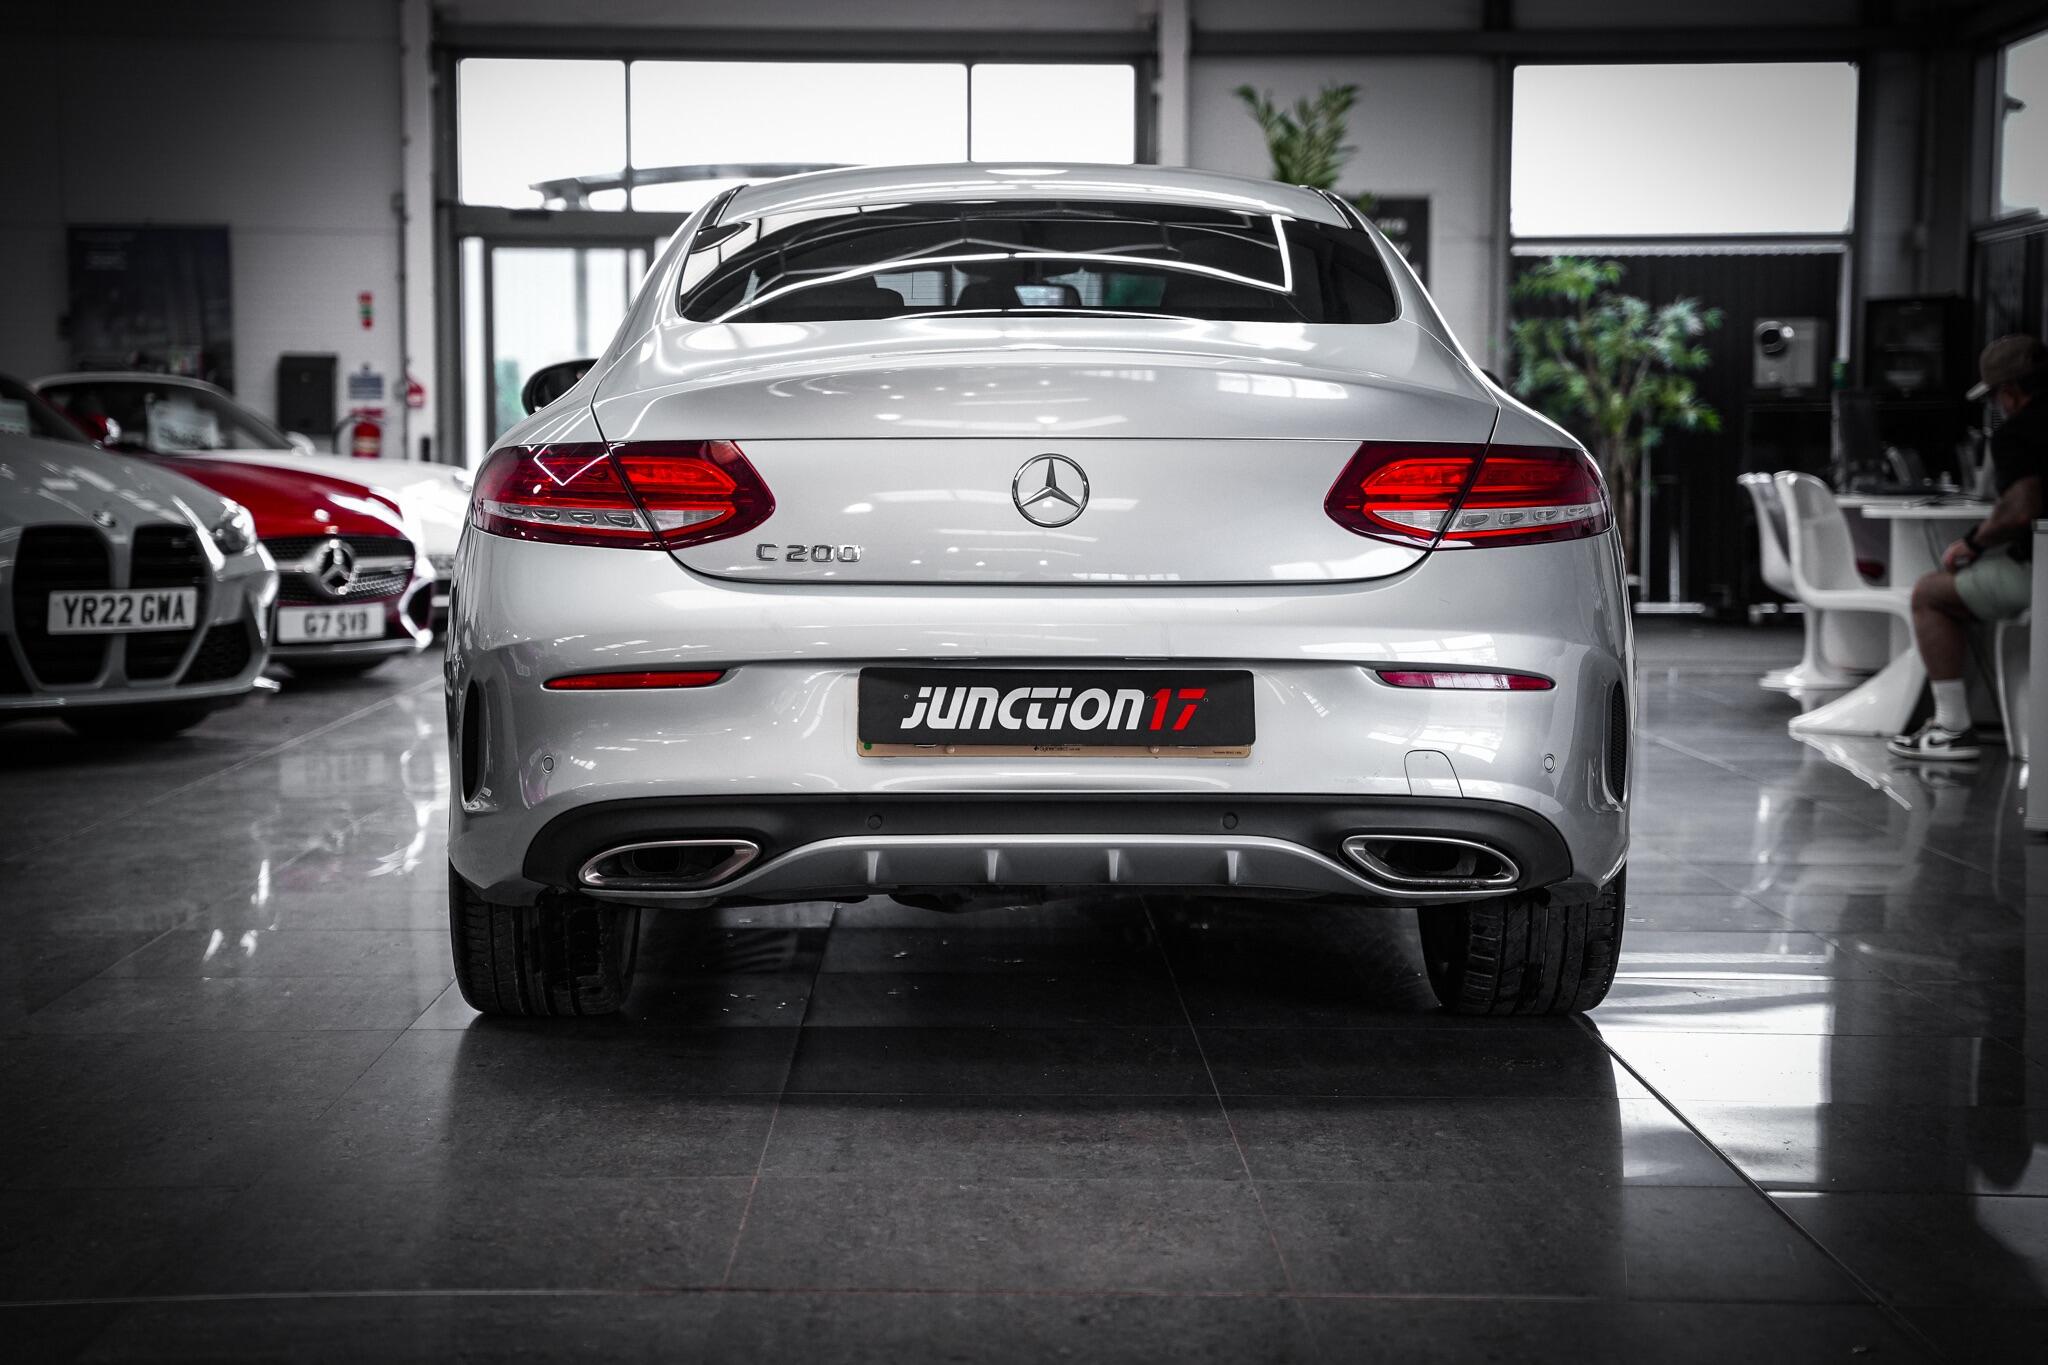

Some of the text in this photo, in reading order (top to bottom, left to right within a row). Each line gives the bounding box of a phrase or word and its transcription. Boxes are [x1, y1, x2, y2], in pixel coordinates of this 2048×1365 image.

[756, 543, 861, 562] C 200
[63, 594, 133, 626] YR22
